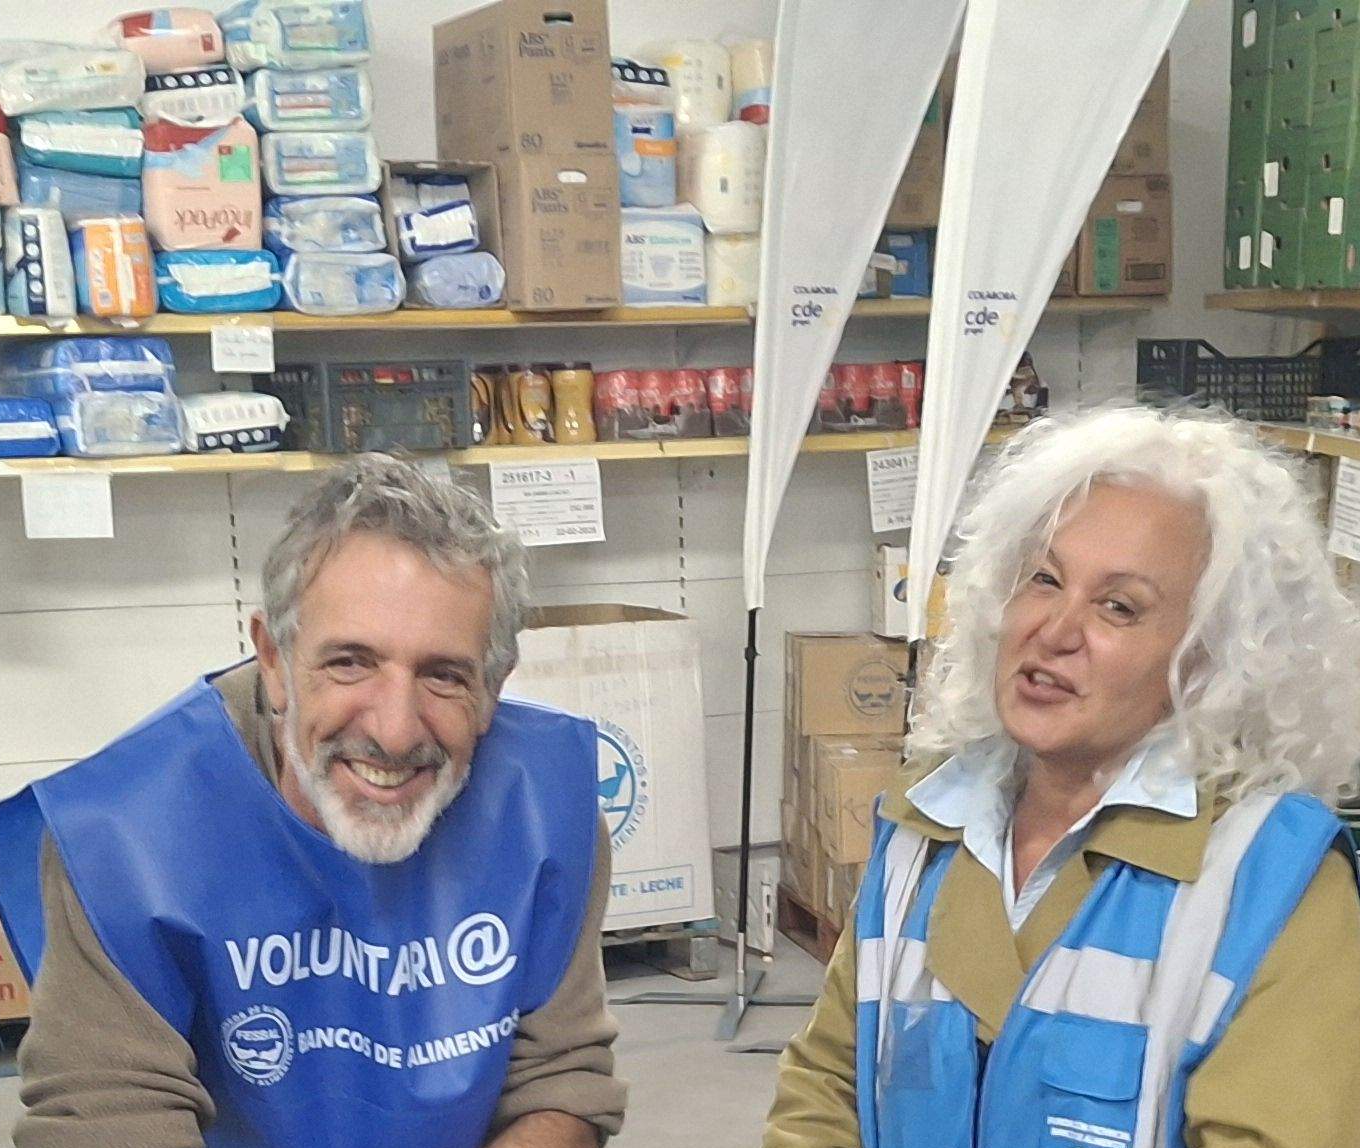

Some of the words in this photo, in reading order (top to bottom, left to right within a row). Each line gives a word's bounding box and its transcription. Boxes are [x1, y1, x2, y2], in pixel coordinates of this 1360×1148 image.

[625, 235, 646, 245] ABS
[791, 300, 823, 319] cde
[964, 306, 999, 326] cde
[502, 469, 553, 484] 251617-3
[639, 876, 685, 894] LECHE
[297, 1026, 372, 1058] BANCOS
[373, 1042, 404, 1069] DE
[405, 1008, 521, 1069] ALIMENTOS
